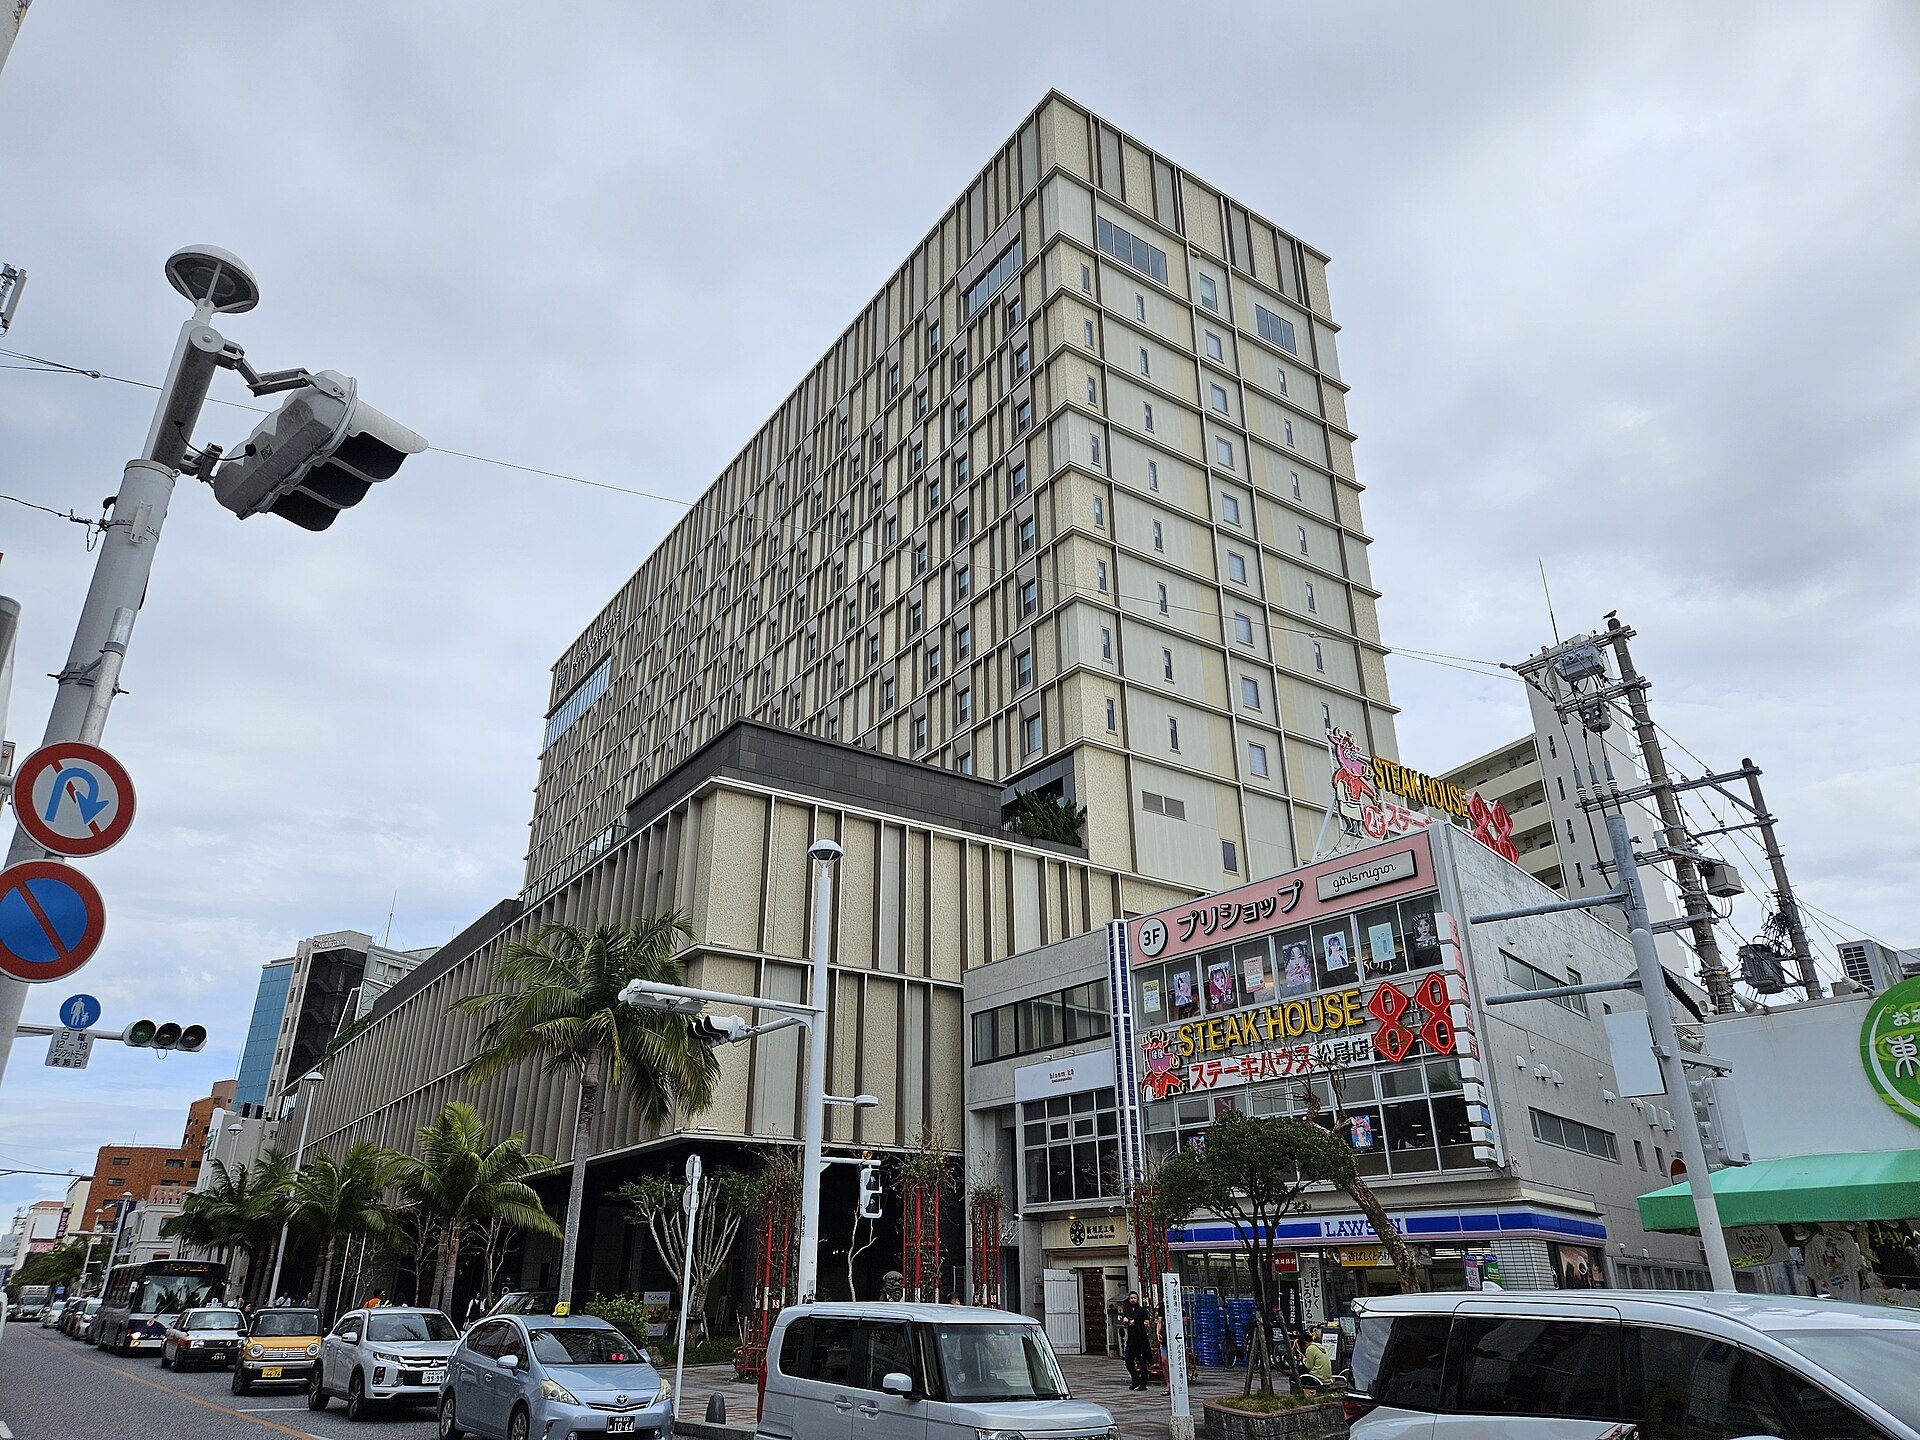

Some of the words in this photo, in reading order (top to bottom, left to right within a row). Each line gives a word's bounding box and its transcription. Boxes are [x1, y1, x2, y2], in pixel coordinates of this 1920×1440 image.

[1372, 756, 1424, 803] STEAK
[1419, 773, 1471, 819] HOUSE
[1468, 791, 1519, 864] 88
[1385, 803, 1434, 831] ステー
[1143, 927, 1161, 947] 3F
[1177, 879, 1303, 941] プリショップ
[1178, 1009, 1261, 1057] STEAK
[1265, 988, 1365, 1041] HOUSE
[1368, 972, 1457, 1063] 88
[1190, 1046, 1315, 1091] ステーキハウス
[1325, 1218, 1403, 1237] LAWSN
[1304, 1278, 1313, 1319] とろける
[1309, 1266, 1320, 1309] 香ばしく
